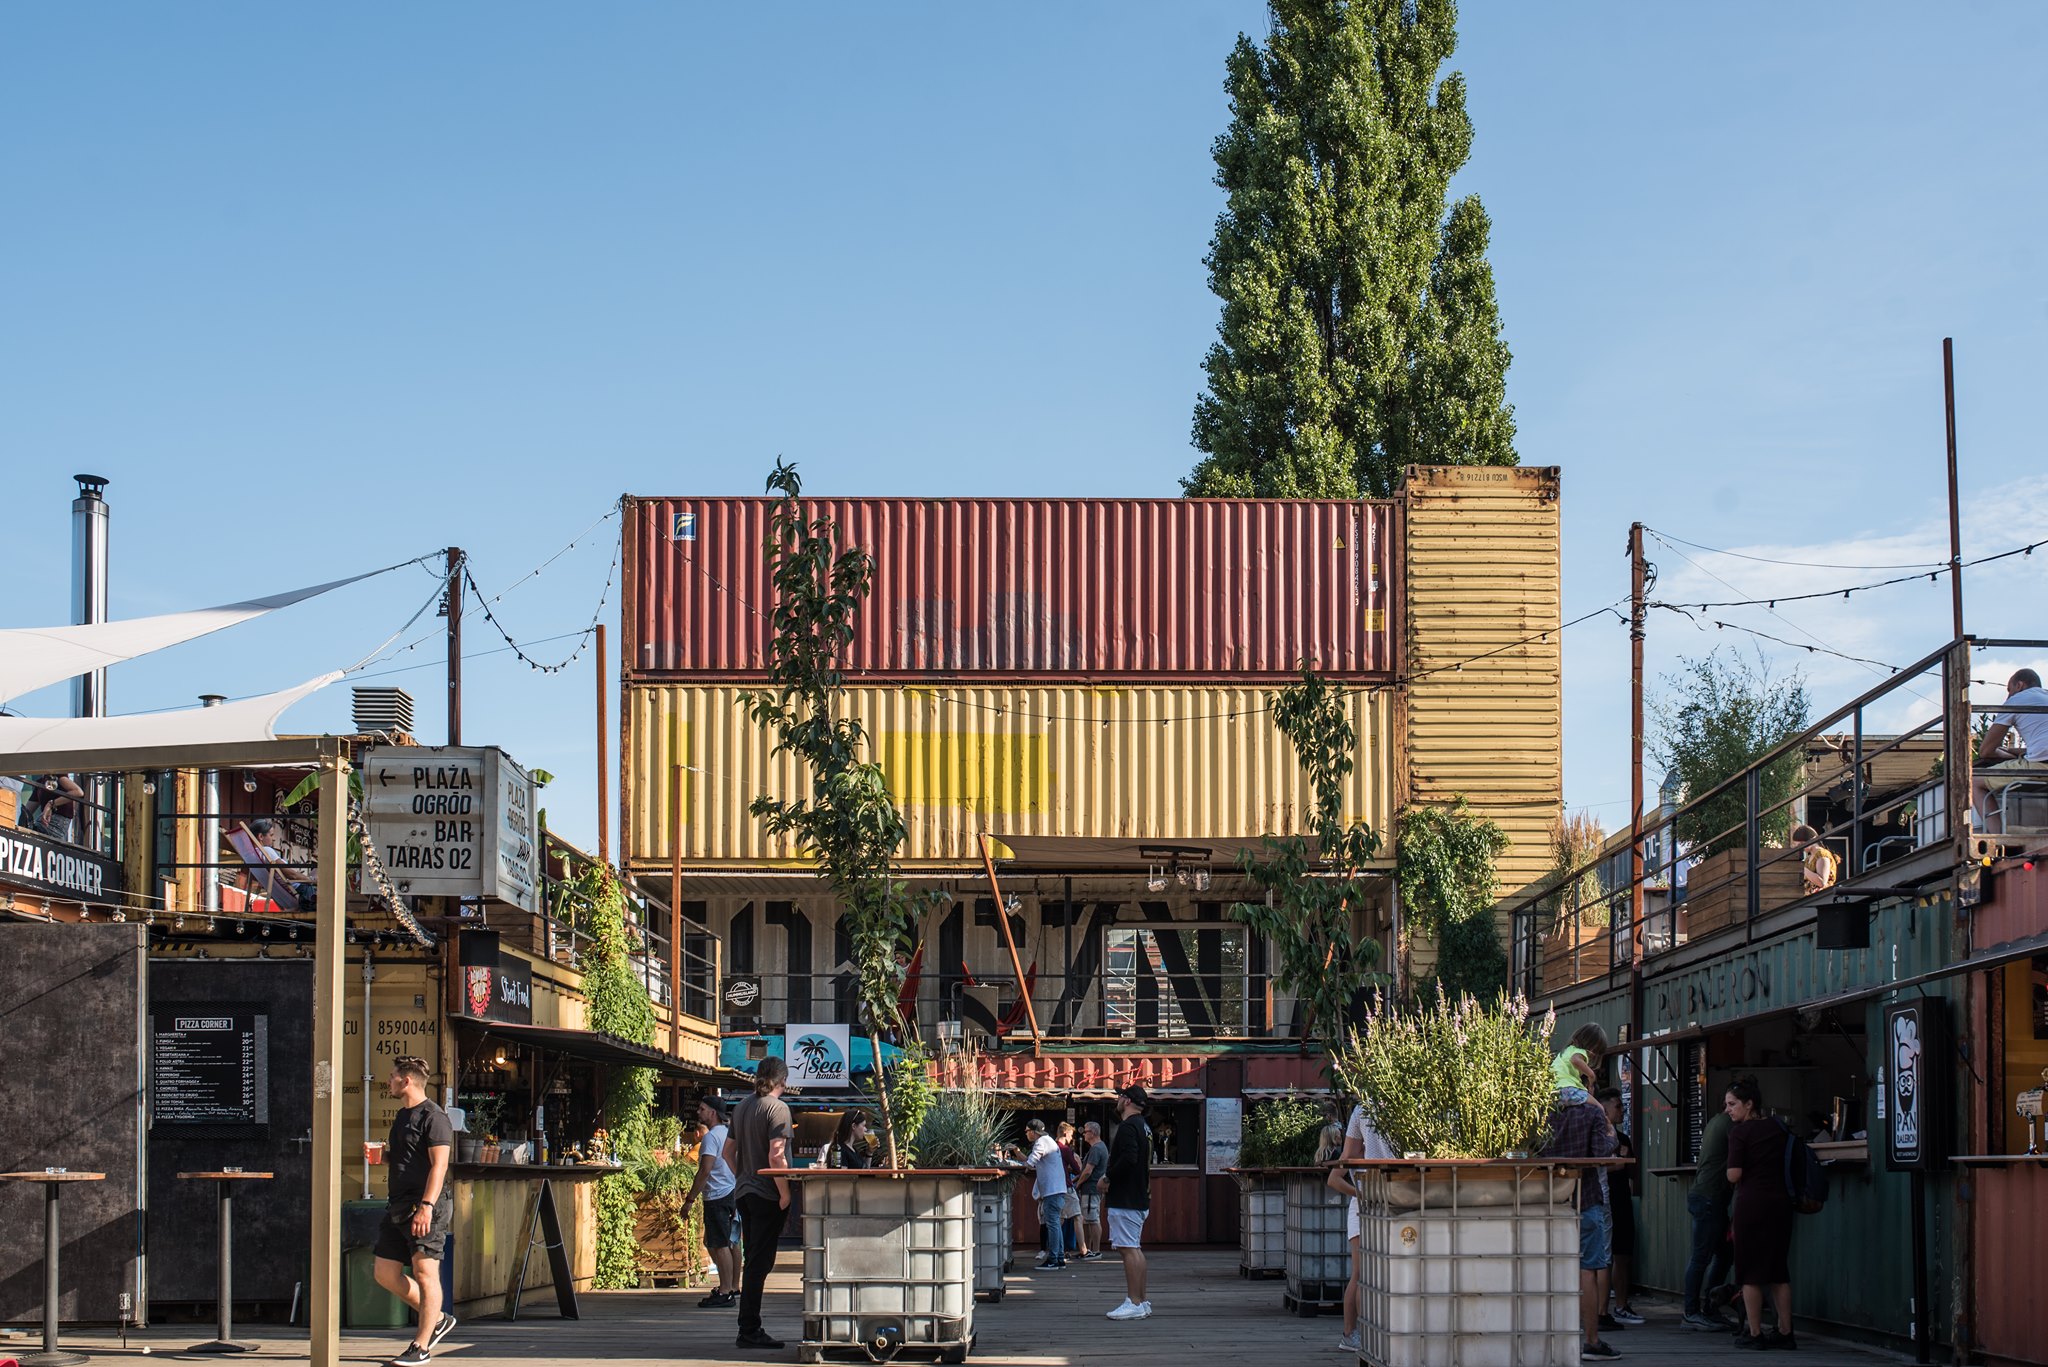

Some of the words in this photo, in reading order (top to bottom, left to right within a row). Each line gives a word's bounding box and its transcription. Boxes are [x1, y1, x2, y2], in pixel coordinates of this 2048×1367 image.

[412, 764, 472, 790] PLAŻA
[435, 820, 472, 842] BAR
[0, 836, 43, 880] PIZZA
[47, 850, 102, 896] CORNER
[386, 846, 444, 870] TARAS
[449, 848, 472, 870] 02
[516, 982, 530, 1008] Food
[180, 1020, 200, 1028] PIZZA
[200, 1020, 228, 1028] CORNER
[344, 1020, 358, 1035] CU
[376, 1040, 407, 1054] 45G1
[808, 1058, 843, 1074] Sea
[1897, 1112, 1916, 1131] PAN
